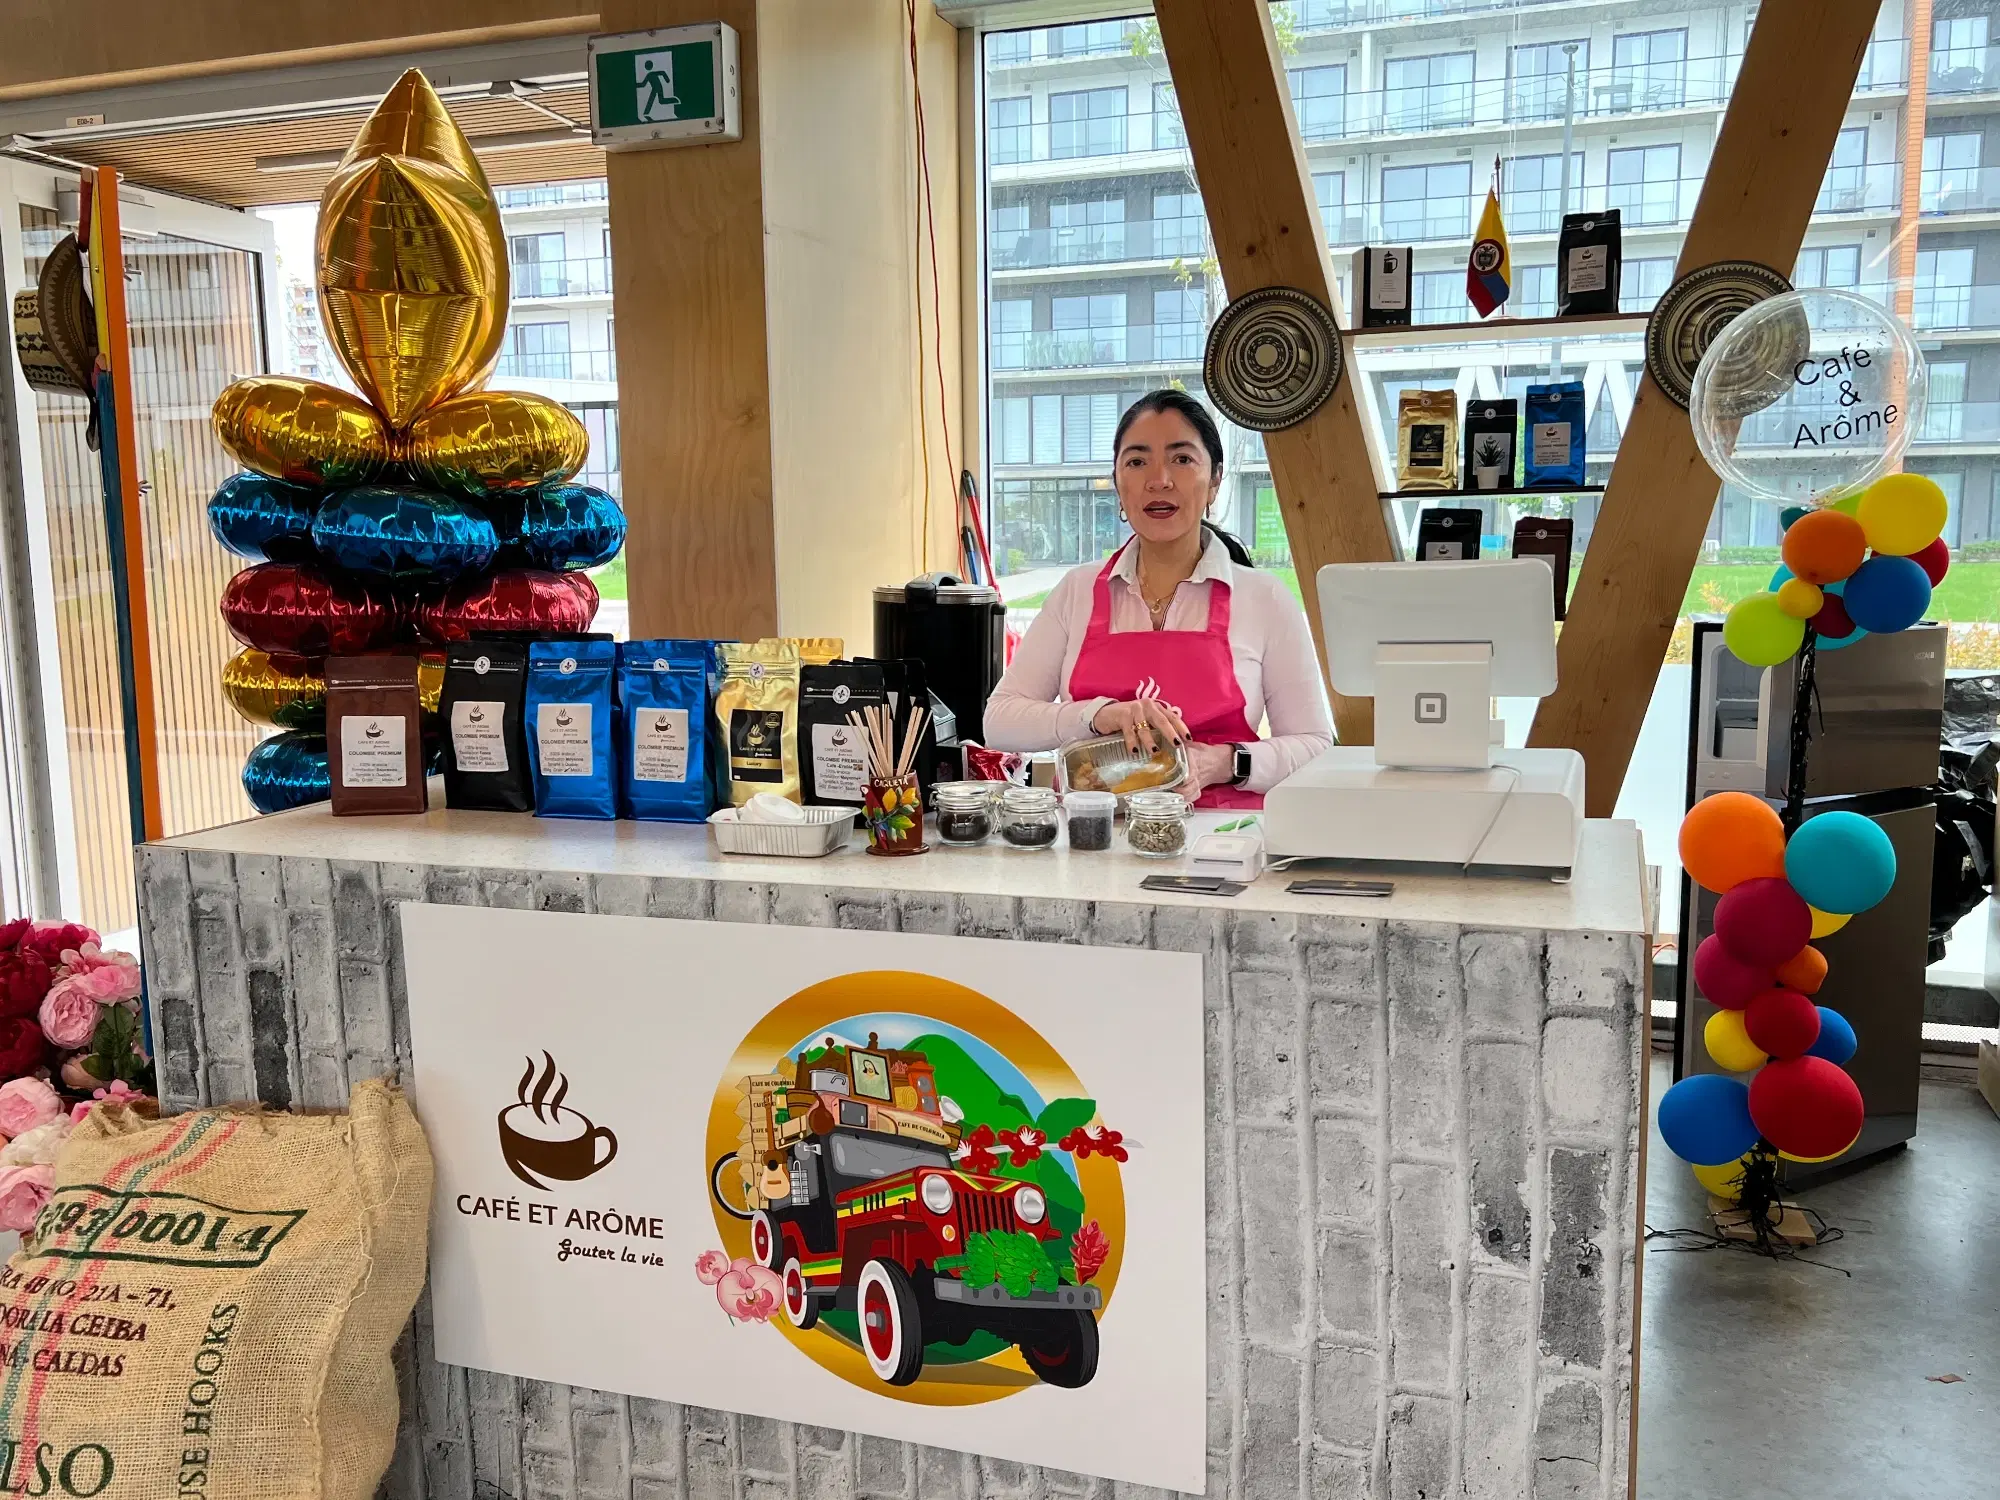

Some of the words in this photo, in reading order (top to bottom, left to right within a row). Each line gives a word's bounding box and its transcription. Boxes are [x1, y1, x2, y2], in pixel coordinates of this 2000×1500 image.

[1793, 342, 1872, 386] Café
[1839, 380, 1862, 407] &
[1793, 404, 1898, 449] Arôme
[456, 1194, 521, 1222] CAFÉ
[528, 1203, 558, 1226] ET
[564, 1208, 664, 1239] ARÔME
[557, 1238, 616, 1262] Gouter
[621, 1246, 637, 1264] la
[641, 1251, 664, 1267] vie
[80, 1284, 121, 1304] 21A
[38, 1310, 64, 1335] LA
[69, 1313, 148, 1342] CEIBA
[33, 1349, 127, 1377] CALDAS
[183, 1304, 240, 1438] HOOKS
